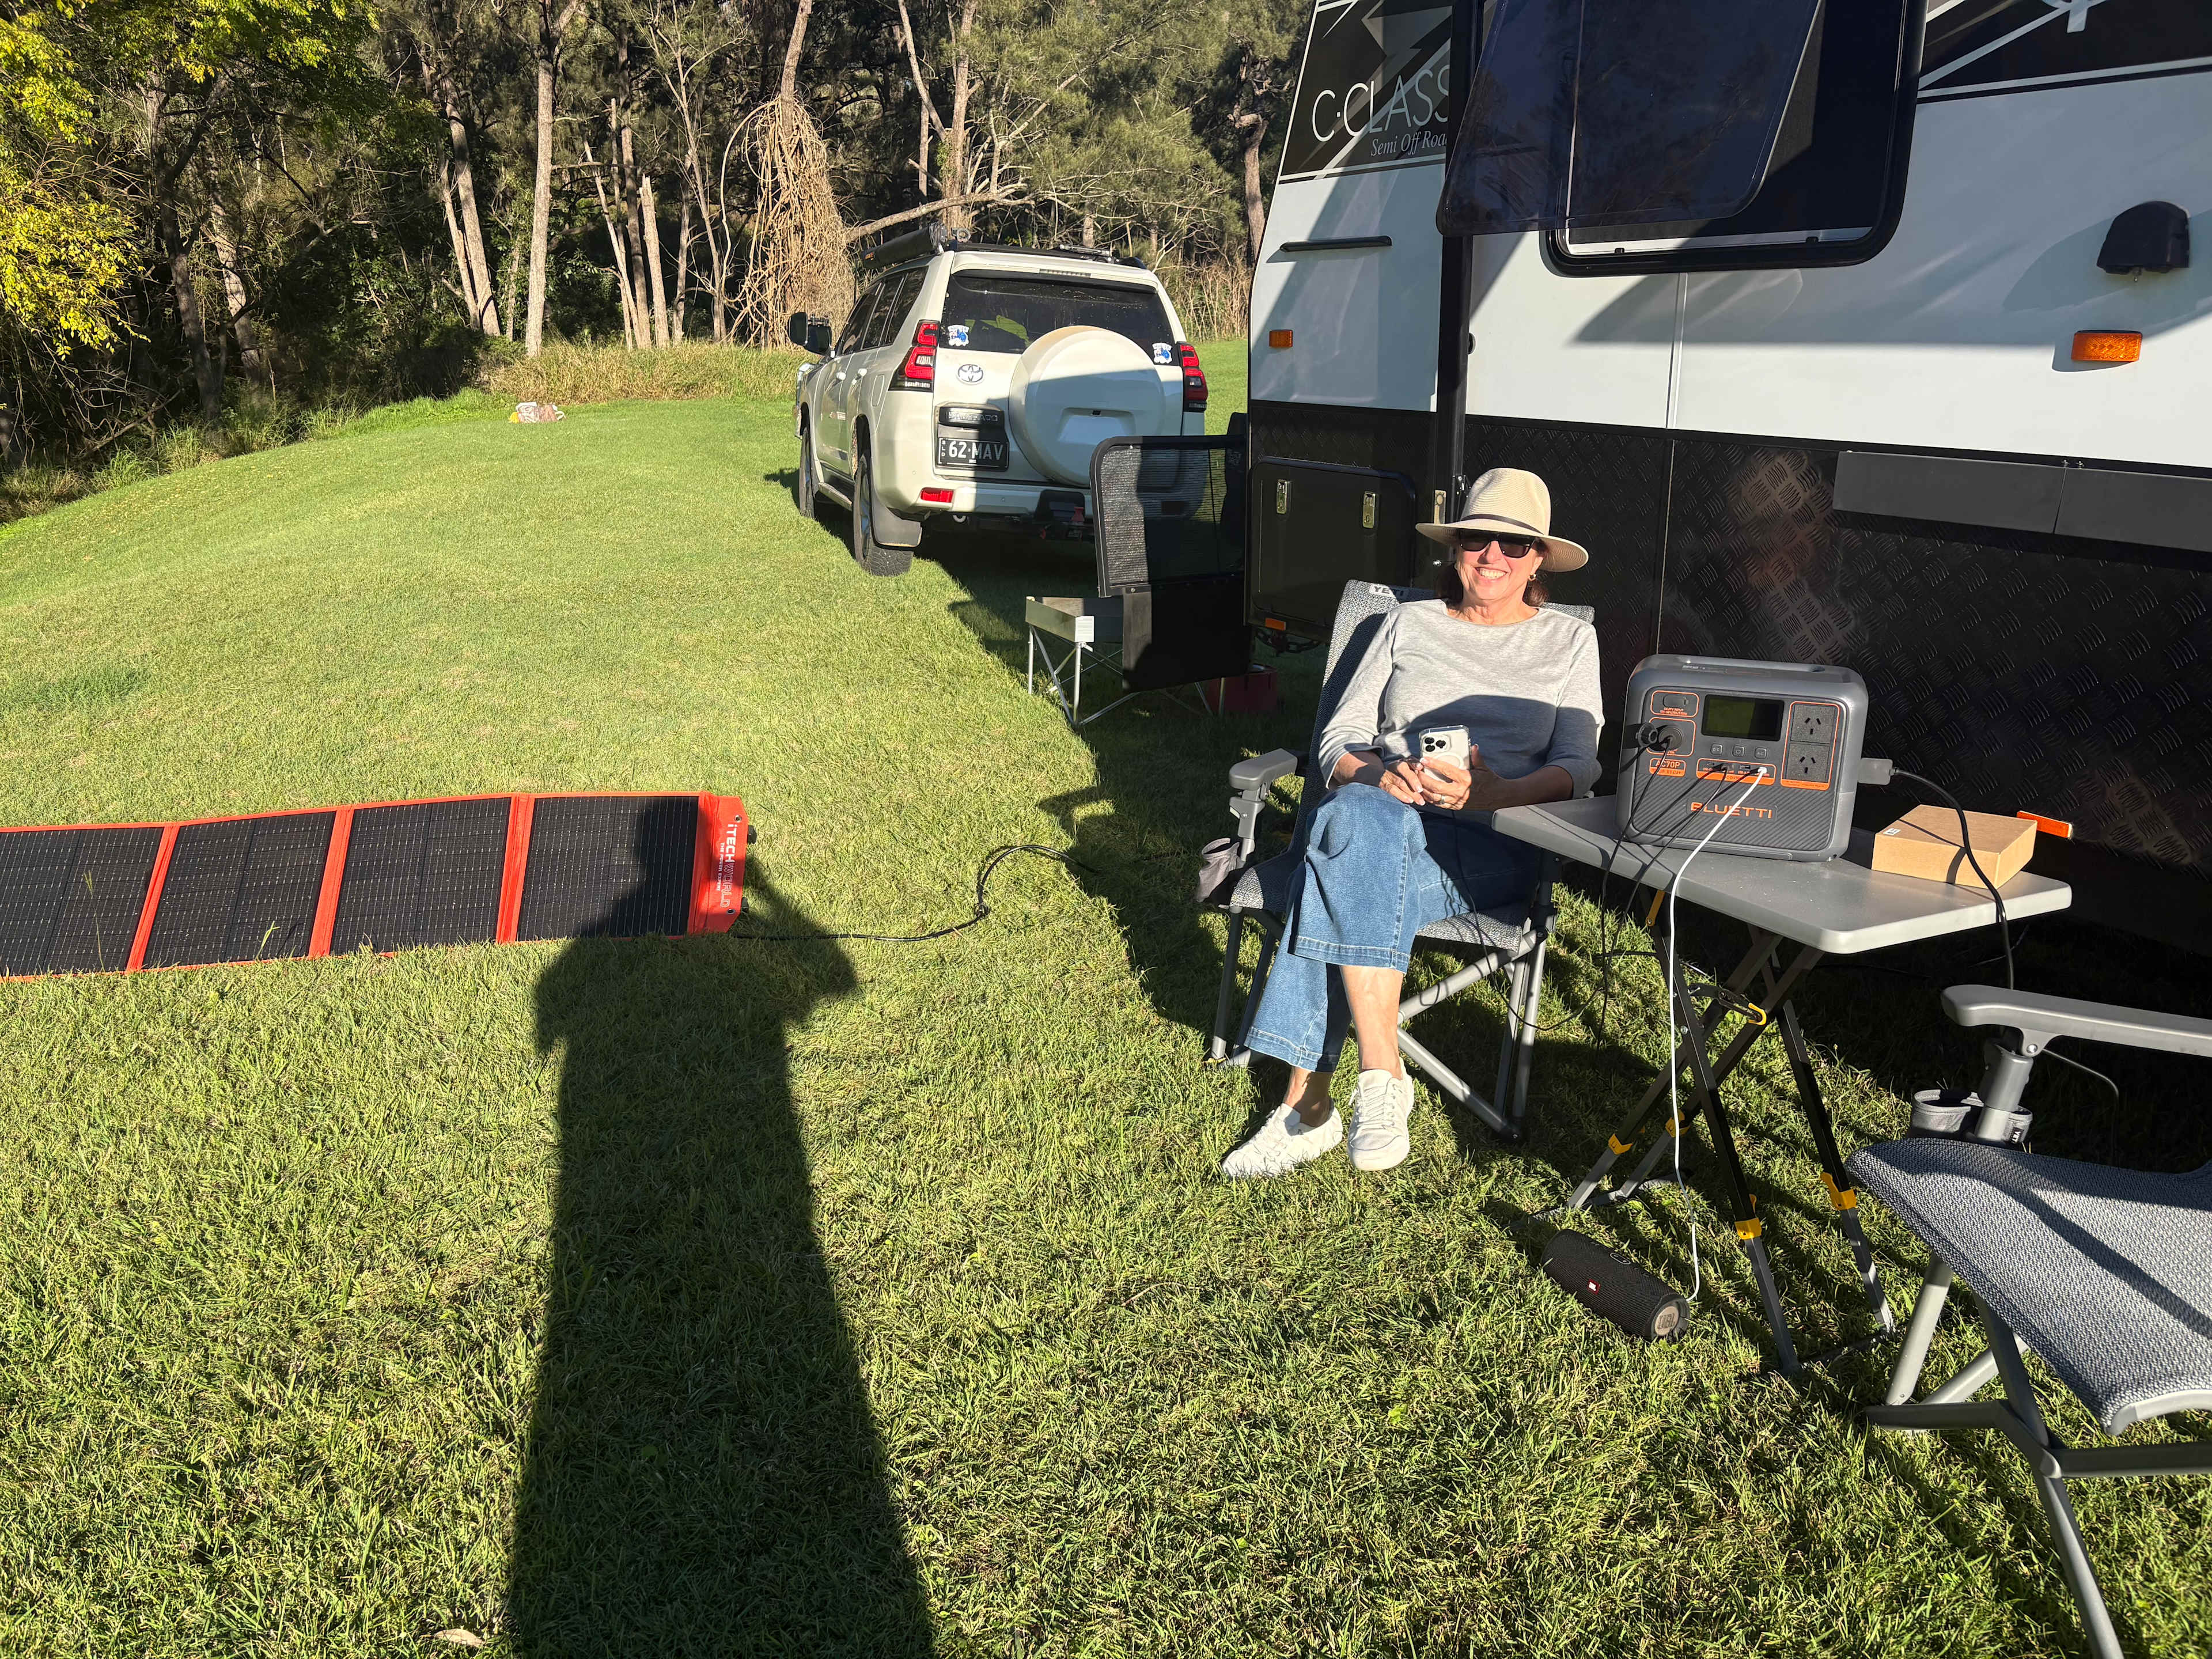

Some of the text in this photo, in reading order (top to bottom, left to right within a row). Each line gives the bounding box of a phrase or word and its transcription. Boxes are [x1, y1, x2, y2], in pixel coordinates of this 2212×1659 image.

[1371, 130, 1447, 156] Semi Off Roa
[1373, 586, 1404, 597] YETI
[1655, 760, 1681, 768] AC70P
[1691, 802, 1772, 819] BLUETTI
